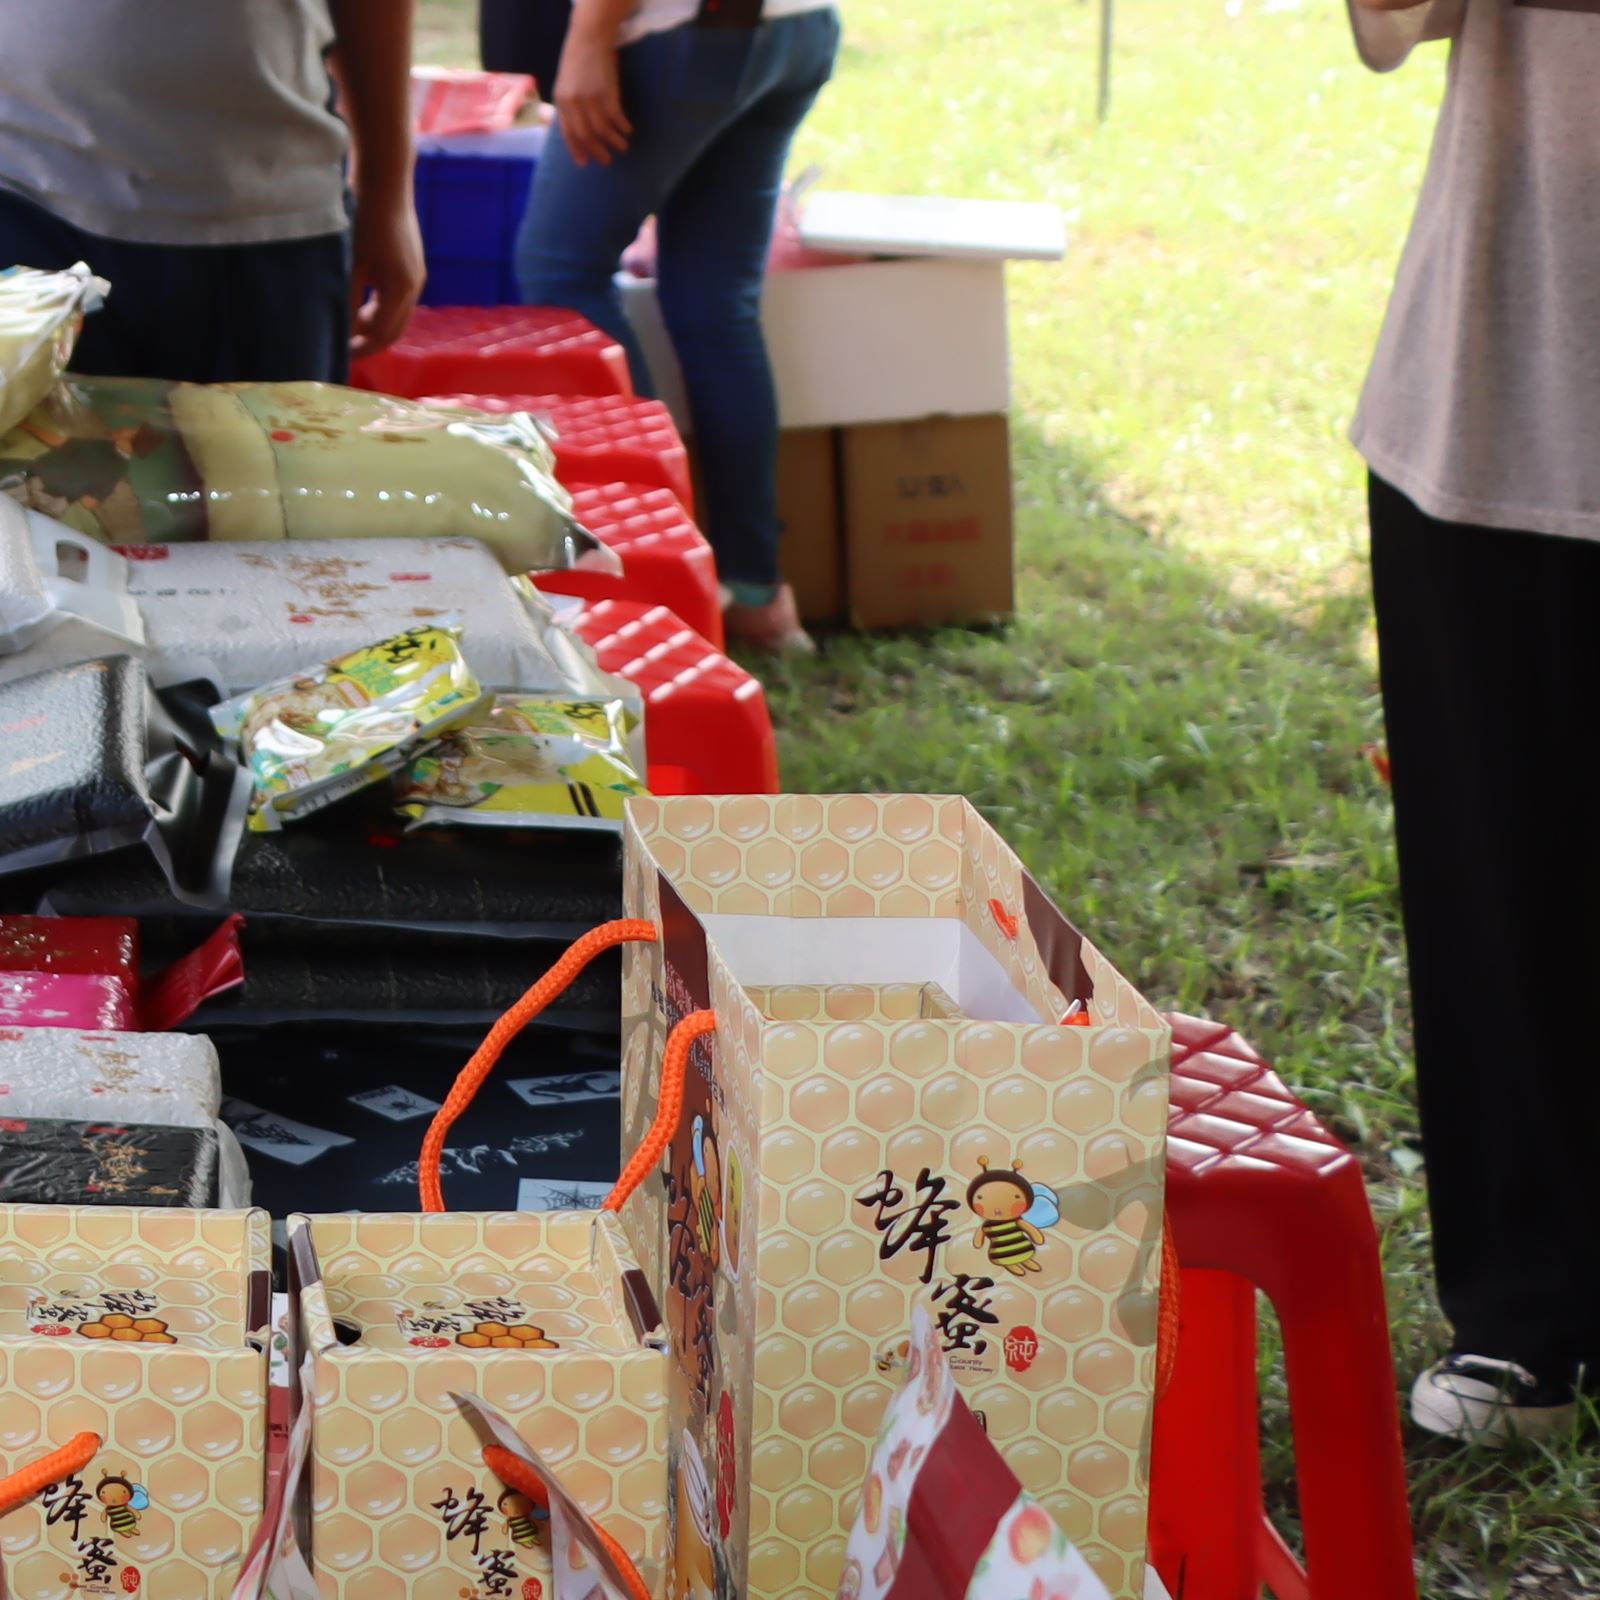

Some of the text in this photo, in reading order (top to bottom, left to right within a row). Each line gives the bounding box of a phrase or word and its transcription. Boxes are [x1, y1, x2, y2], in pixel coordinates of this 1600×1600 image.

[854, 1167, 999, 1355] 蜂蜜
[36, 1473, 118, 1584] 蜂蜜
[430, 1486, 519, 1597] 蜂蜜
